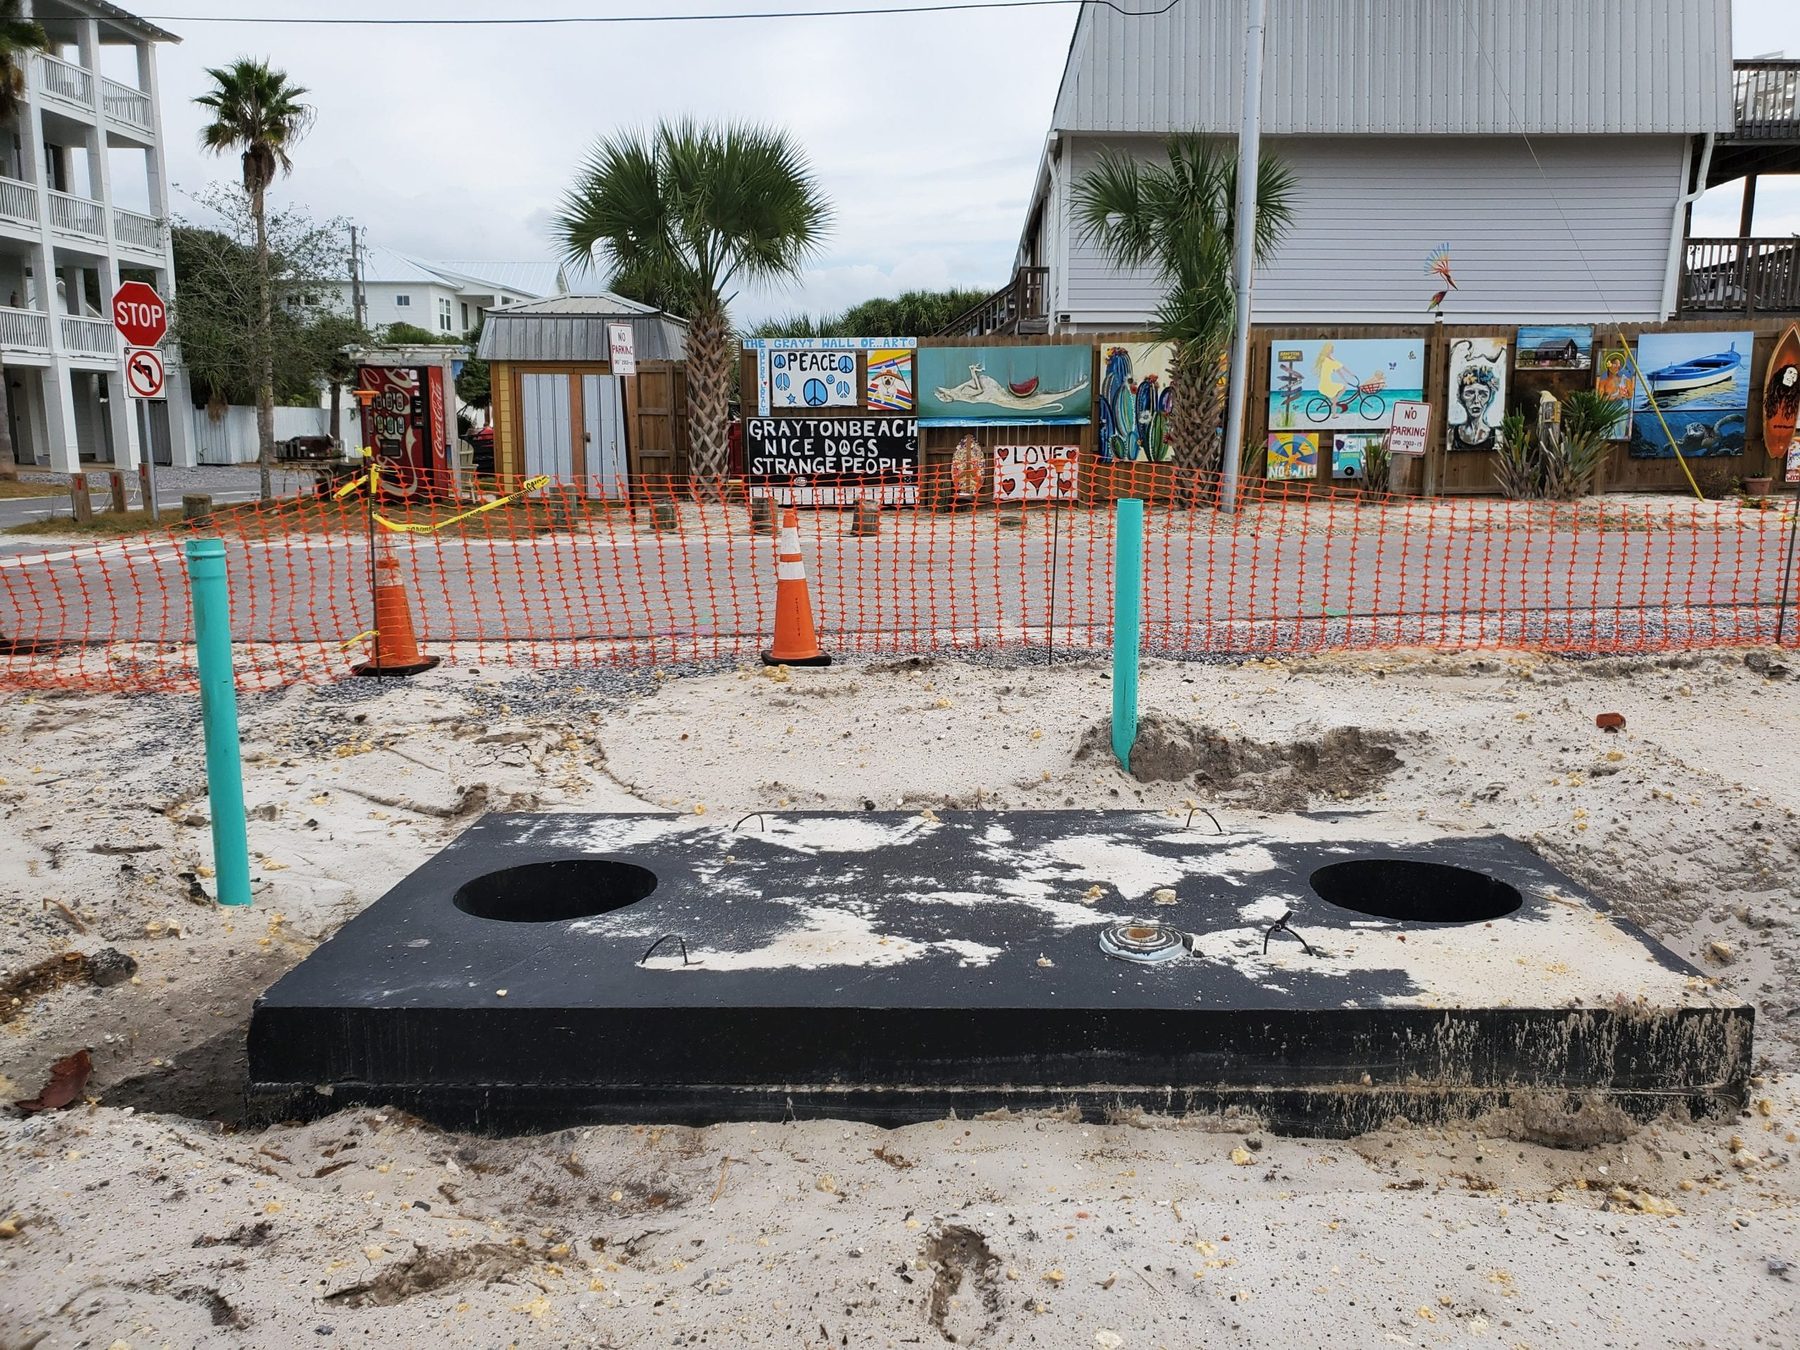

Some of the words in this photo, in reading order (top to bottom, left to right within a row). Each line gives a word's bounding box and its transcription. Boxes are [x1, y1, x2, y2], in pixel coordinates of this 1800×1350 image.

[116, 301, 162, 328] STOP
[617, 332, 626, 342] NO
[744, 339, 766, 349] THE
[774, 339, 814, 348] GRAYT
[821, 339, 855, 348] WALL
[787, 353, 838, 371] PEACE
[1404, 410, 1418, 420] NO
[1391, 425, 1426, 437] PARKING
[765, 439, 815, 456] NICE
[752, 457, 838, 475] STRANGE
[841, 458, 914, 474] PEOPLE
